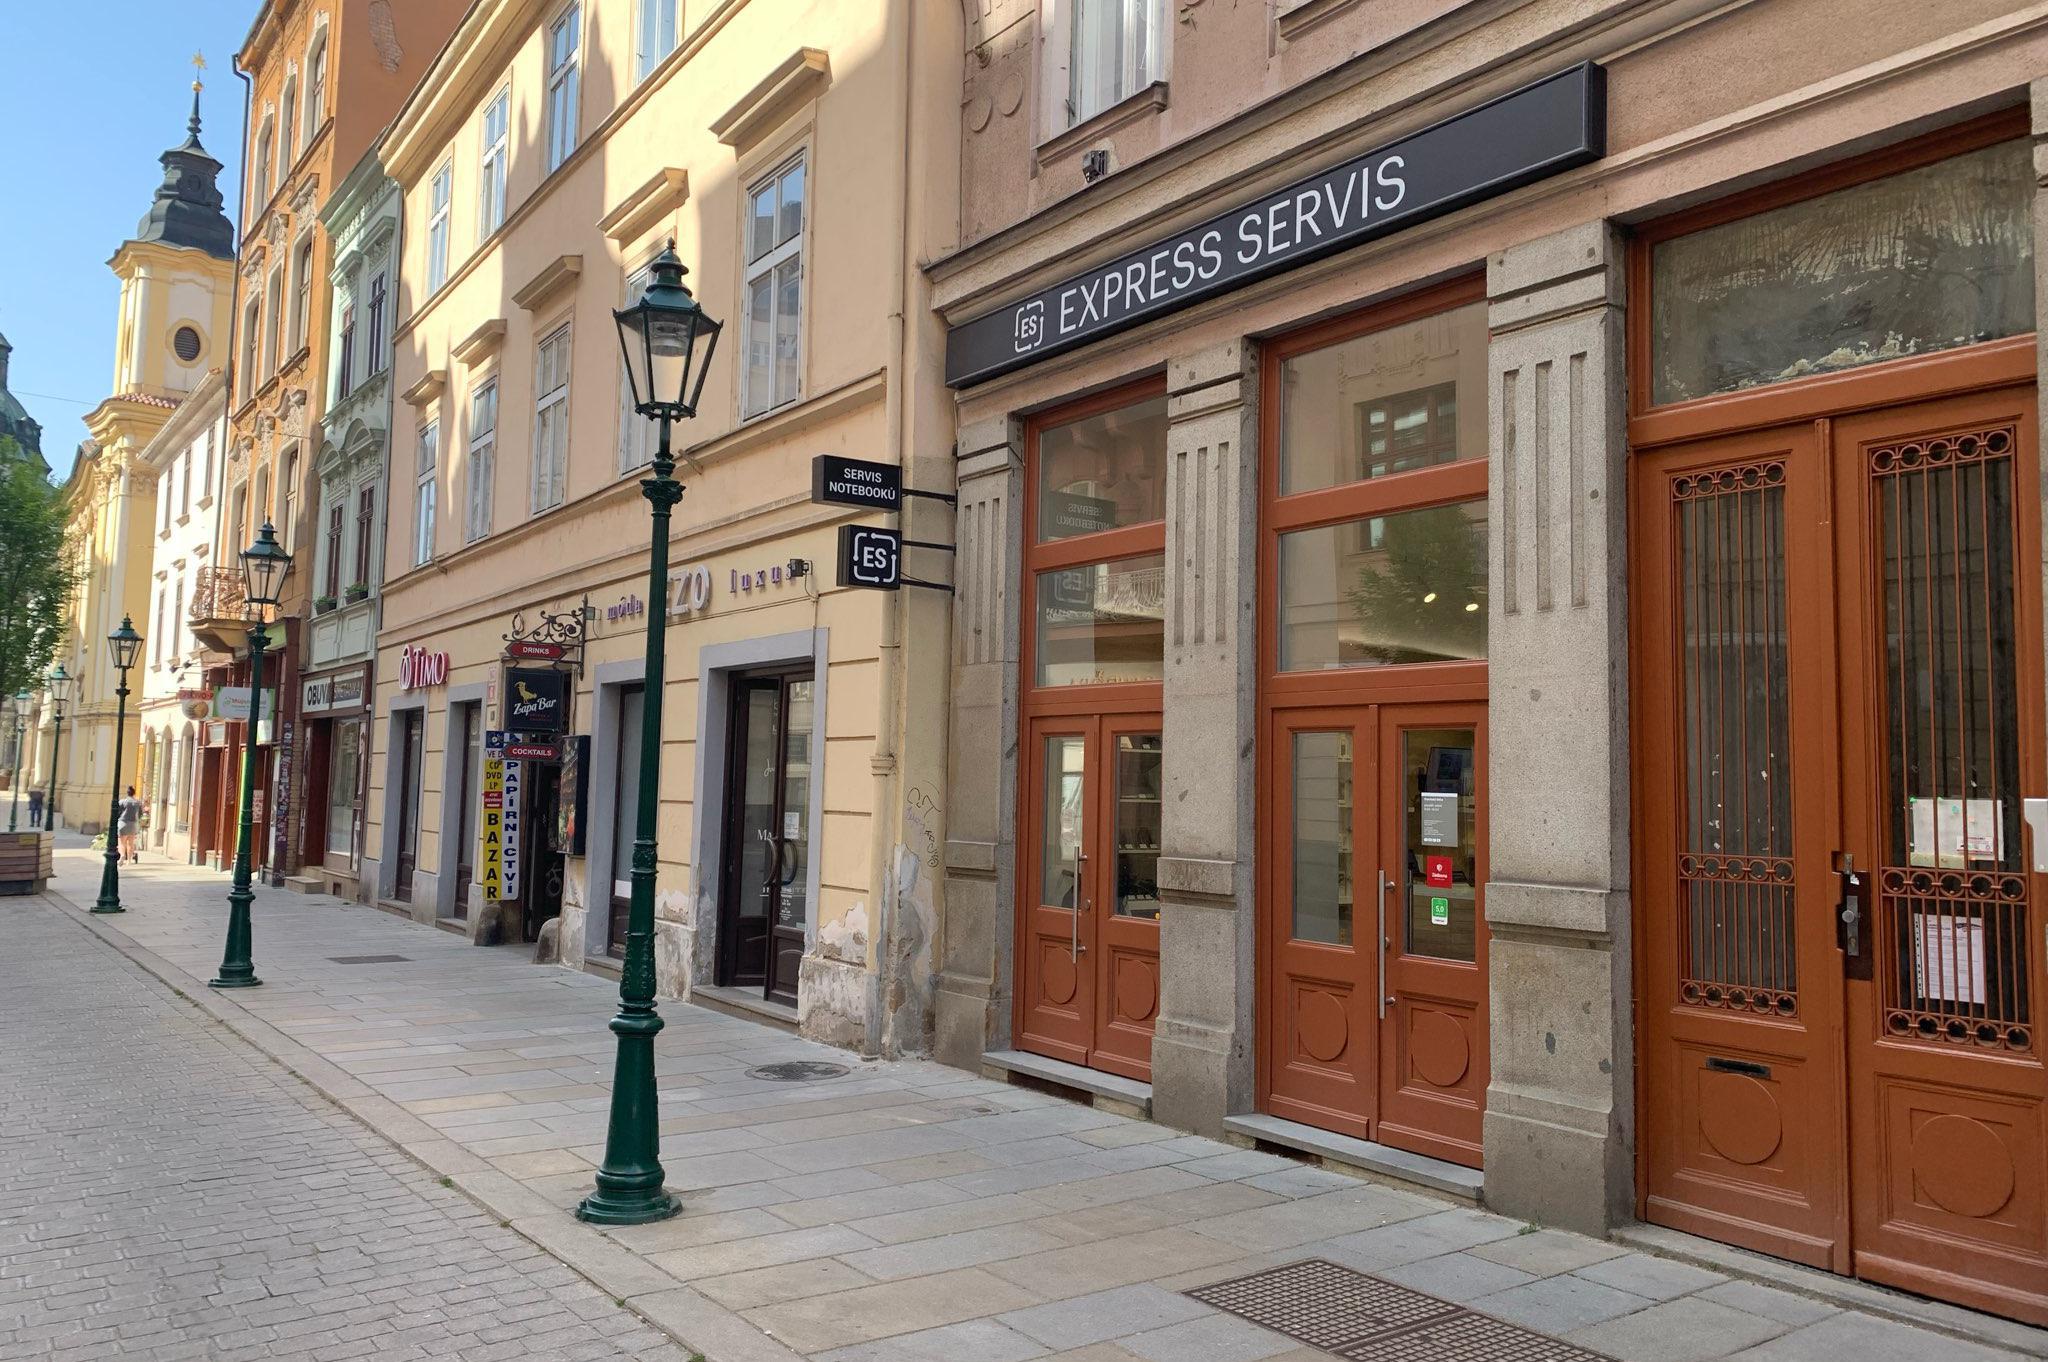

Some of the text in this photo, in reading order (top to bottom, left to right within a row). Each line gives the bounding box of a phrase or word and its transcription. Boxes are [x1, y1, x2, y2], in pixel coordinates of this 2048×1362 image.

[1059, 155, 1407, 335] EXPRESS SERVIS
[1020, 314, 1038, 339] ES
[844, 468, 882, 483] SERVIS
[829, 481, 895, 500] NOTEBOOKŮ
[863, 546, 887, 569] ES
[665, 564, 710, 617] ZO
[522, 646, 549, 655] DRINKS
[513, 697, 557, 716] Zapa Bar
[512, 748, 552, 756] COCKTAILS
[486, 772, 502, 780] DVD
[503, 761, 519, 893] PAPÍRNICTVÍ
[486, 813, 499, 898] BAZAR
